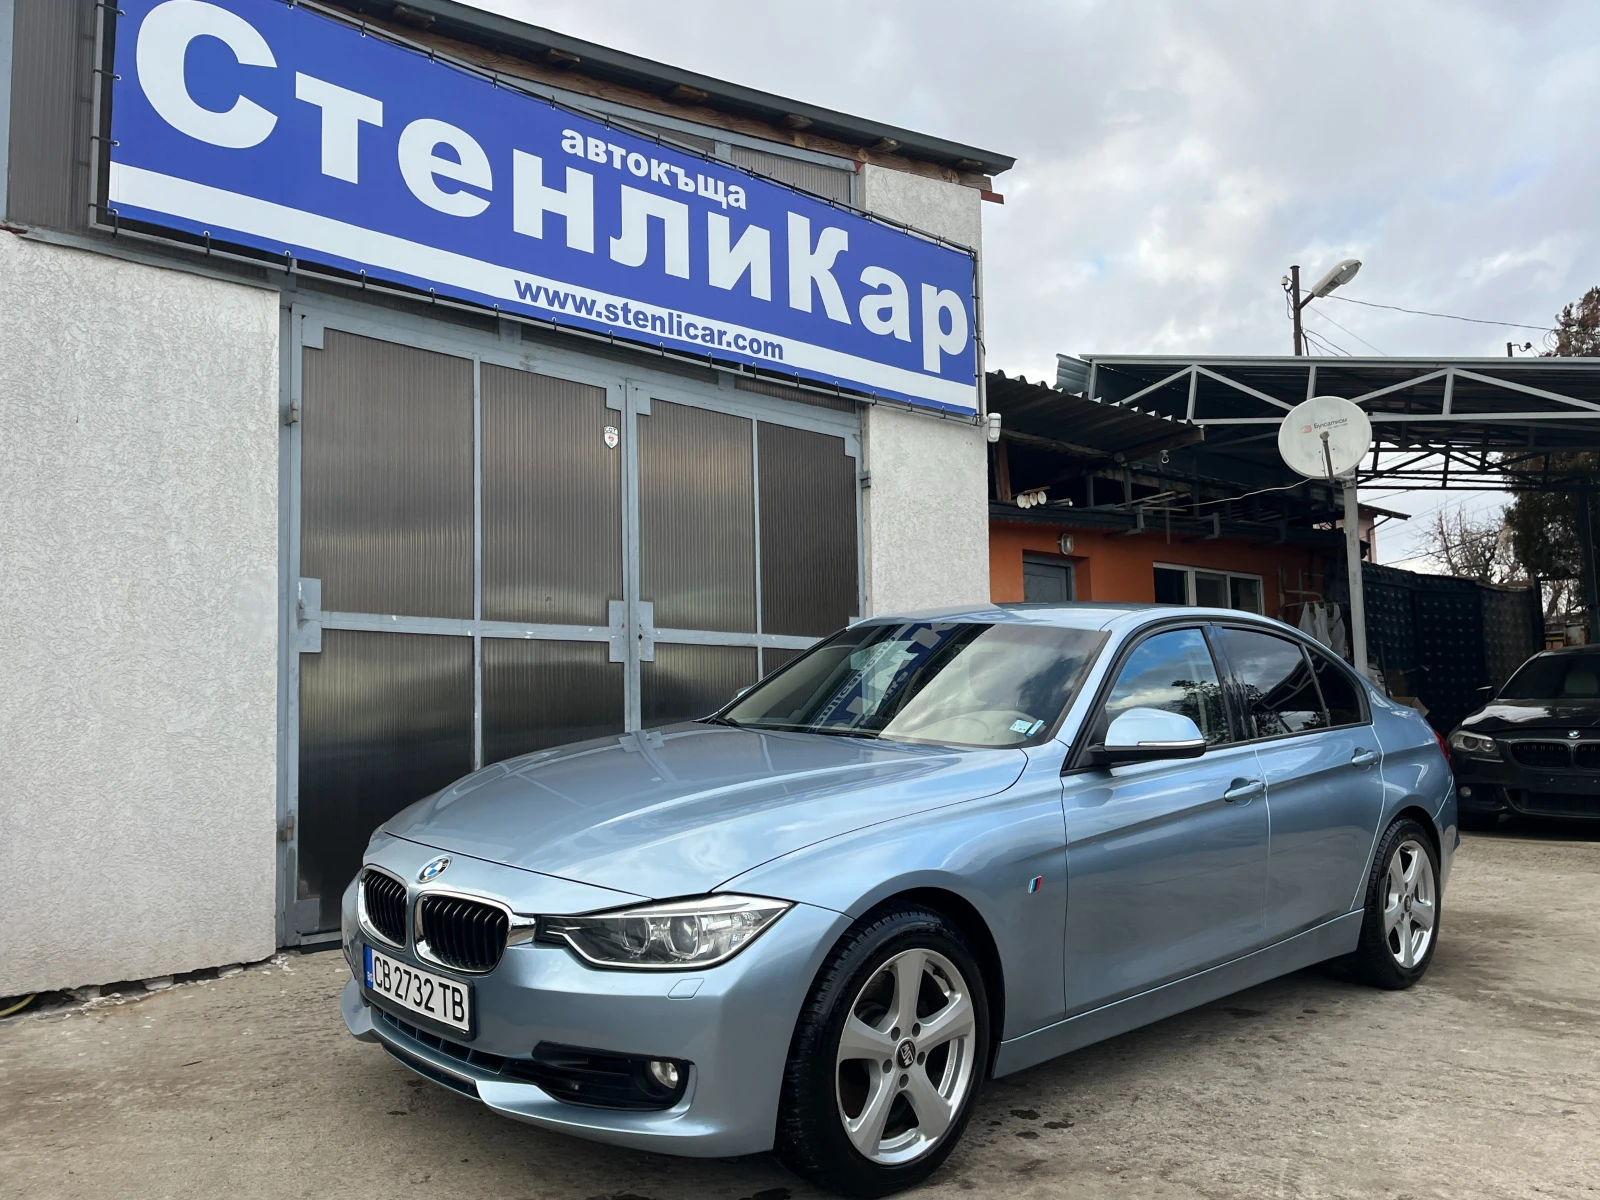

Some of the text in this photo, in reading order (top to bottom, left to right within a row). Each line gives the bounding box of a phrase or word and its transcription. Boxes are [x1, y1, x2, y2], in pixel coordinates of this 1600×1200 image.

[136, 0, 968, 373] СтенлиКар
[561, 128, 746, 210] автокъща
[514, 280, 783, 360] www.stenlicar.com
